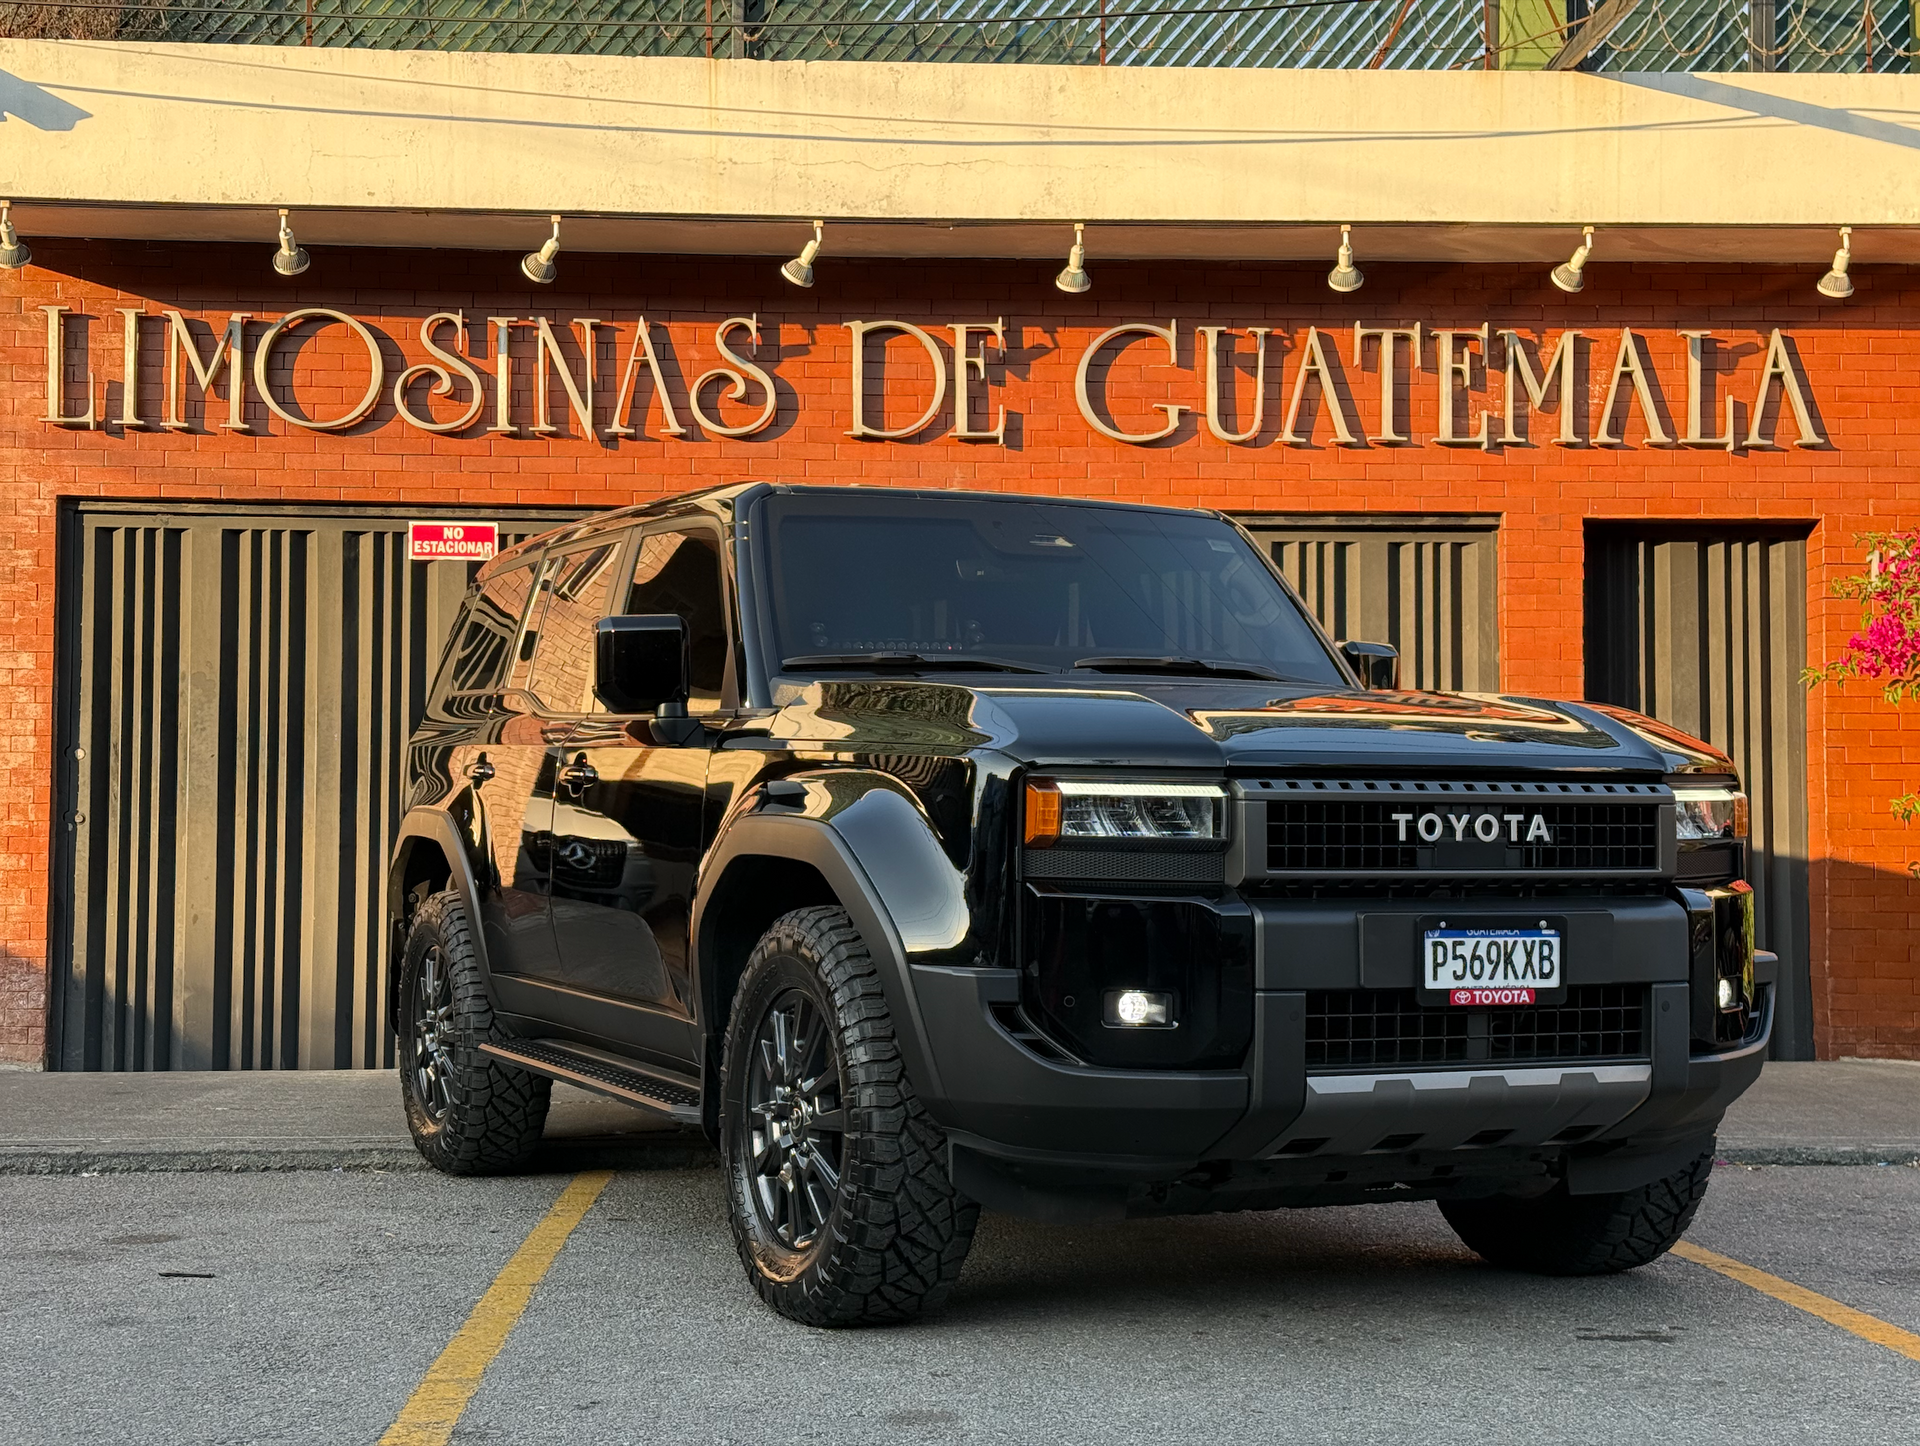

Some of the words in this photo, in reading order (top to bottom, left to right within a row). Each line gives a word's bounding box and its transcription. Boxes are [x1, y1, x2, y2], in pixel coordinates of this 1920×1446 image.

[38, 304, 778, 441] LIMOSINAS
[843, 316, 1007, 445] DE
[1075, 319, 1825, 451] GUATEMALA
[443, 527, 464, 540] NO
[414, 540, 493, 554] ESTACIONAR
[1391, 813, 1551, 842] TOYOTA
[1431, 939, 1555, 981] P569KXB
[1473, 990, 1531, 1004] TOYOTA
